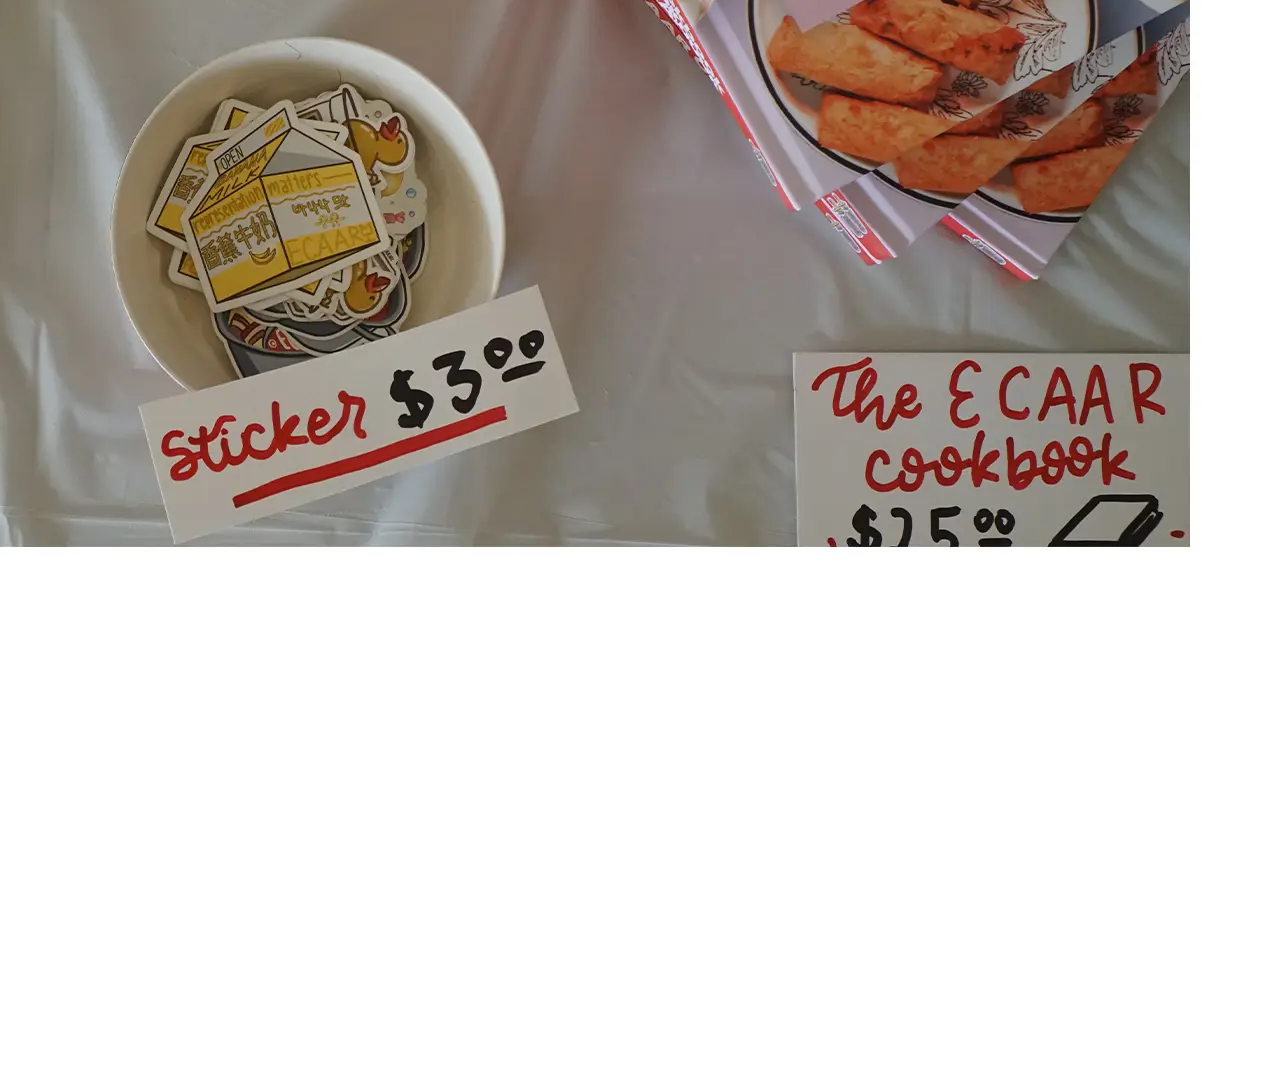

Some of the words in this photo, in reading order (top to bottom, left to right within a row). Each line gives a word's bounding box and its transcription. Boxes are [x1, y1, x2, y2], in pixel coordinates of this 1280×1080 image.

[199, 166, 259, 210] MILK
[220, 147, 244, 169] OPEN
[193, 184, 263, 235] representation
[268, 171, 322, 197] matters
[201, 211, 278, 270] 香蕉牛奶
[811, 357, 923, 431] The
[949, 359, 1167, 429] ECAAR
[864, 430, 1137, 493] cookbook
